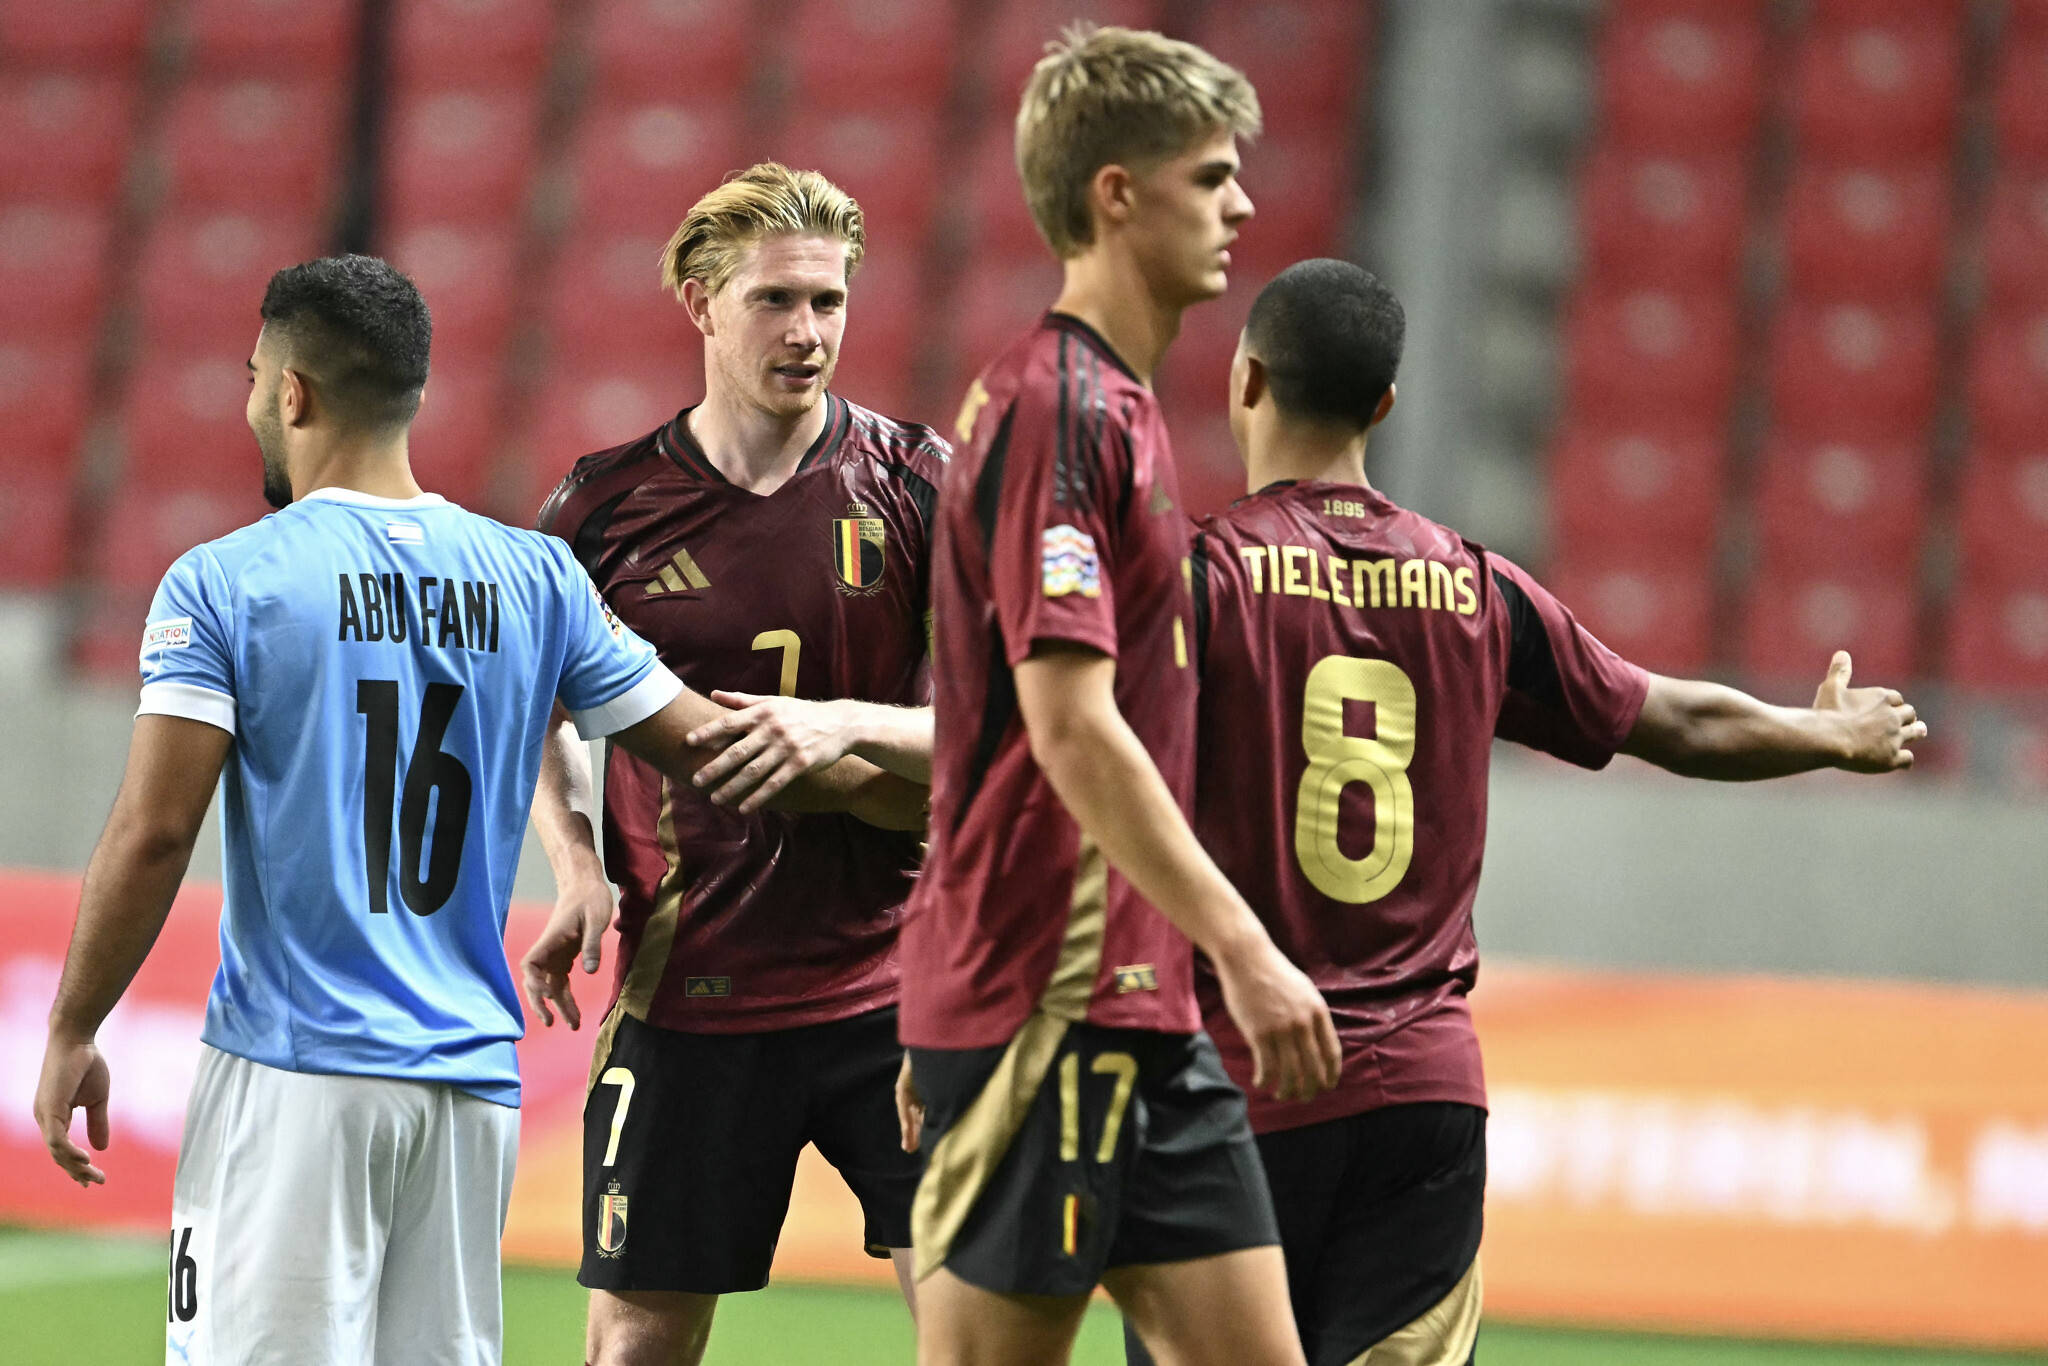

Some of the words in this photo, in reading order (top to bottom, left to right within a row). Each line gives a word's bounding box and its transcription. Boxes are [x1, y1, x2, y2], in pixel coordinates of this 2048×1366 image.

[1323, 499, 1365, 518] 1895
[338, 572, 407, 644] ABU
[418, 576, 500, 653] FANI
[1239, 545, 1477, 615] TIELEMANS
[751, 629, 801, 698] 7
[357, 680, 472, 917] 16
[1296, 655, 1416, 904] 8
[601, 1067, 635, 1166] 7
[1060, 1052, 1137, 1163] 17
